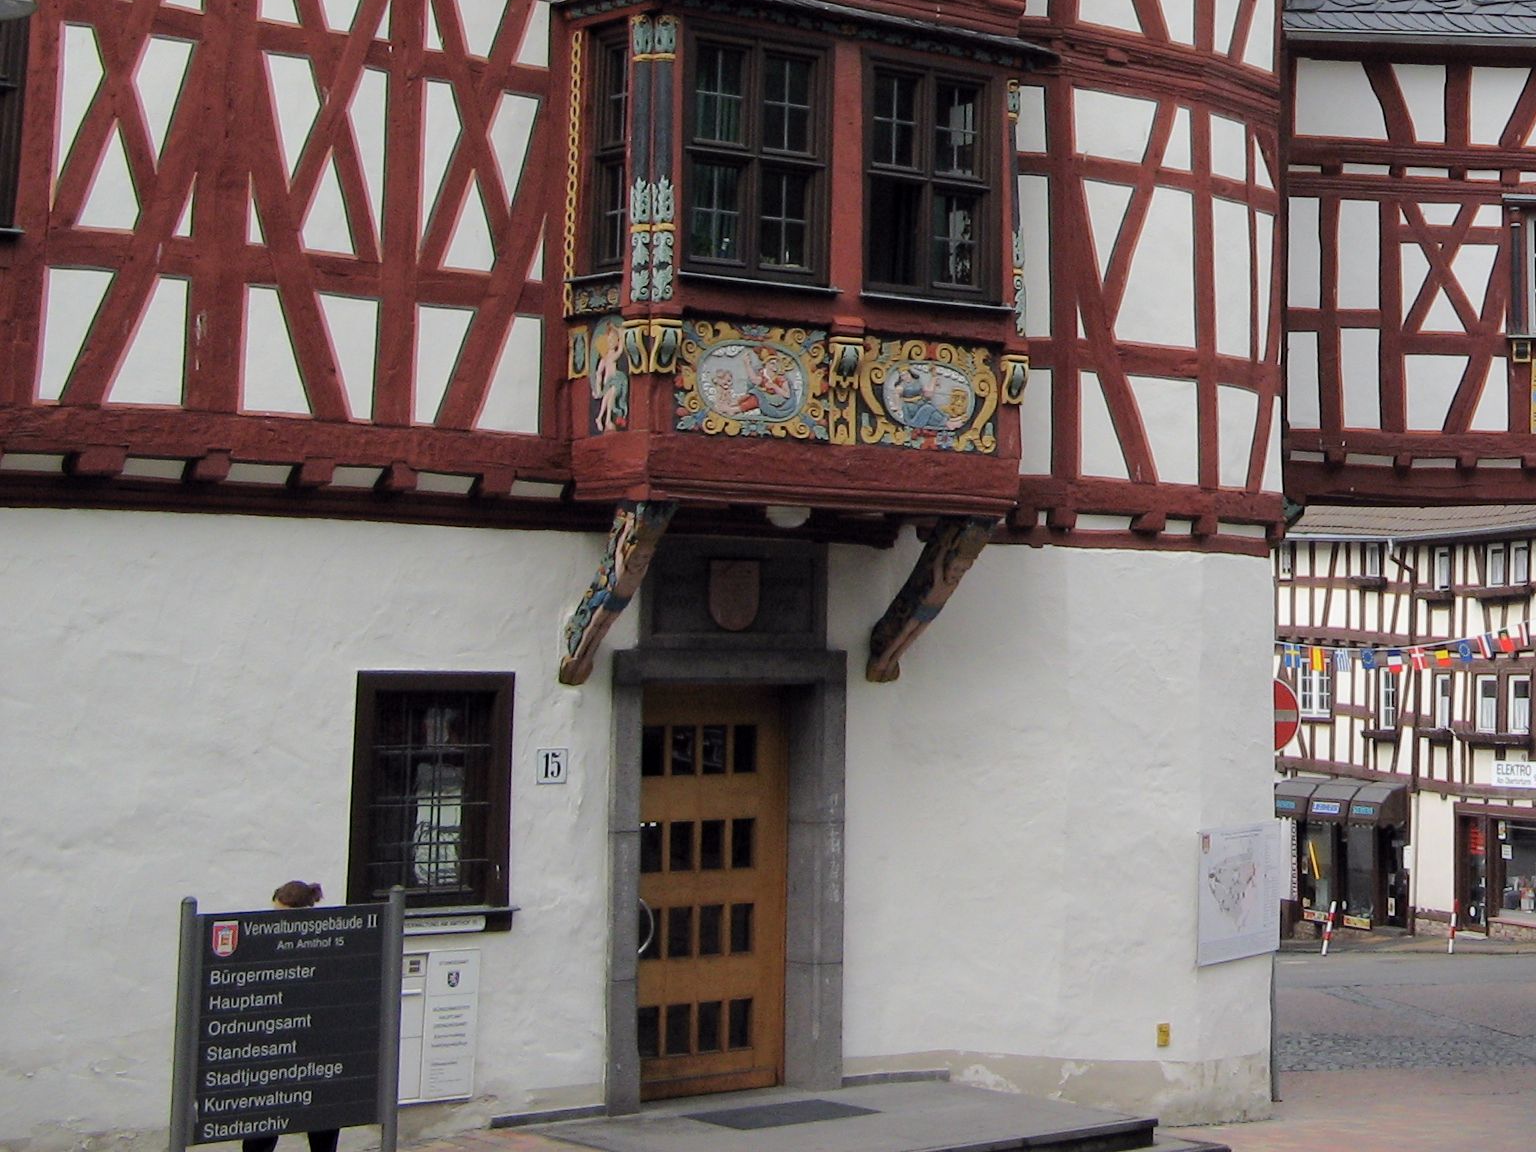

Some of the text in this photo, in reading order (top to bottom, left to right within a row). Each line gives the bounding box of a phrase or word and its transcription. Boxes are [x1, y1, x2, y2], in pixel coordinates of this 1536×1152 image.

[543, 752, 562, 779] 15
[1496, 763, 1532, 776] ELEKTRO
[244, 913, 378, 936] Verwaltungsgebäude II
[276, 936, 345, 951] Am Amthof 15
[210, 964, 316, 987] Bürgermeister
[208, 991, 283, 1012] Hauptamt
[207, 1013, 312, 1037] Ordnungsamt
[206, 1039, 298, 1061] Standesamt
[205, 1061, 344, 1087] Stadtjugendpflege
[203, 1088, 313, 1113] Kurverwaltung
[203, 1116, 290, 1139] Stadtarchiv
